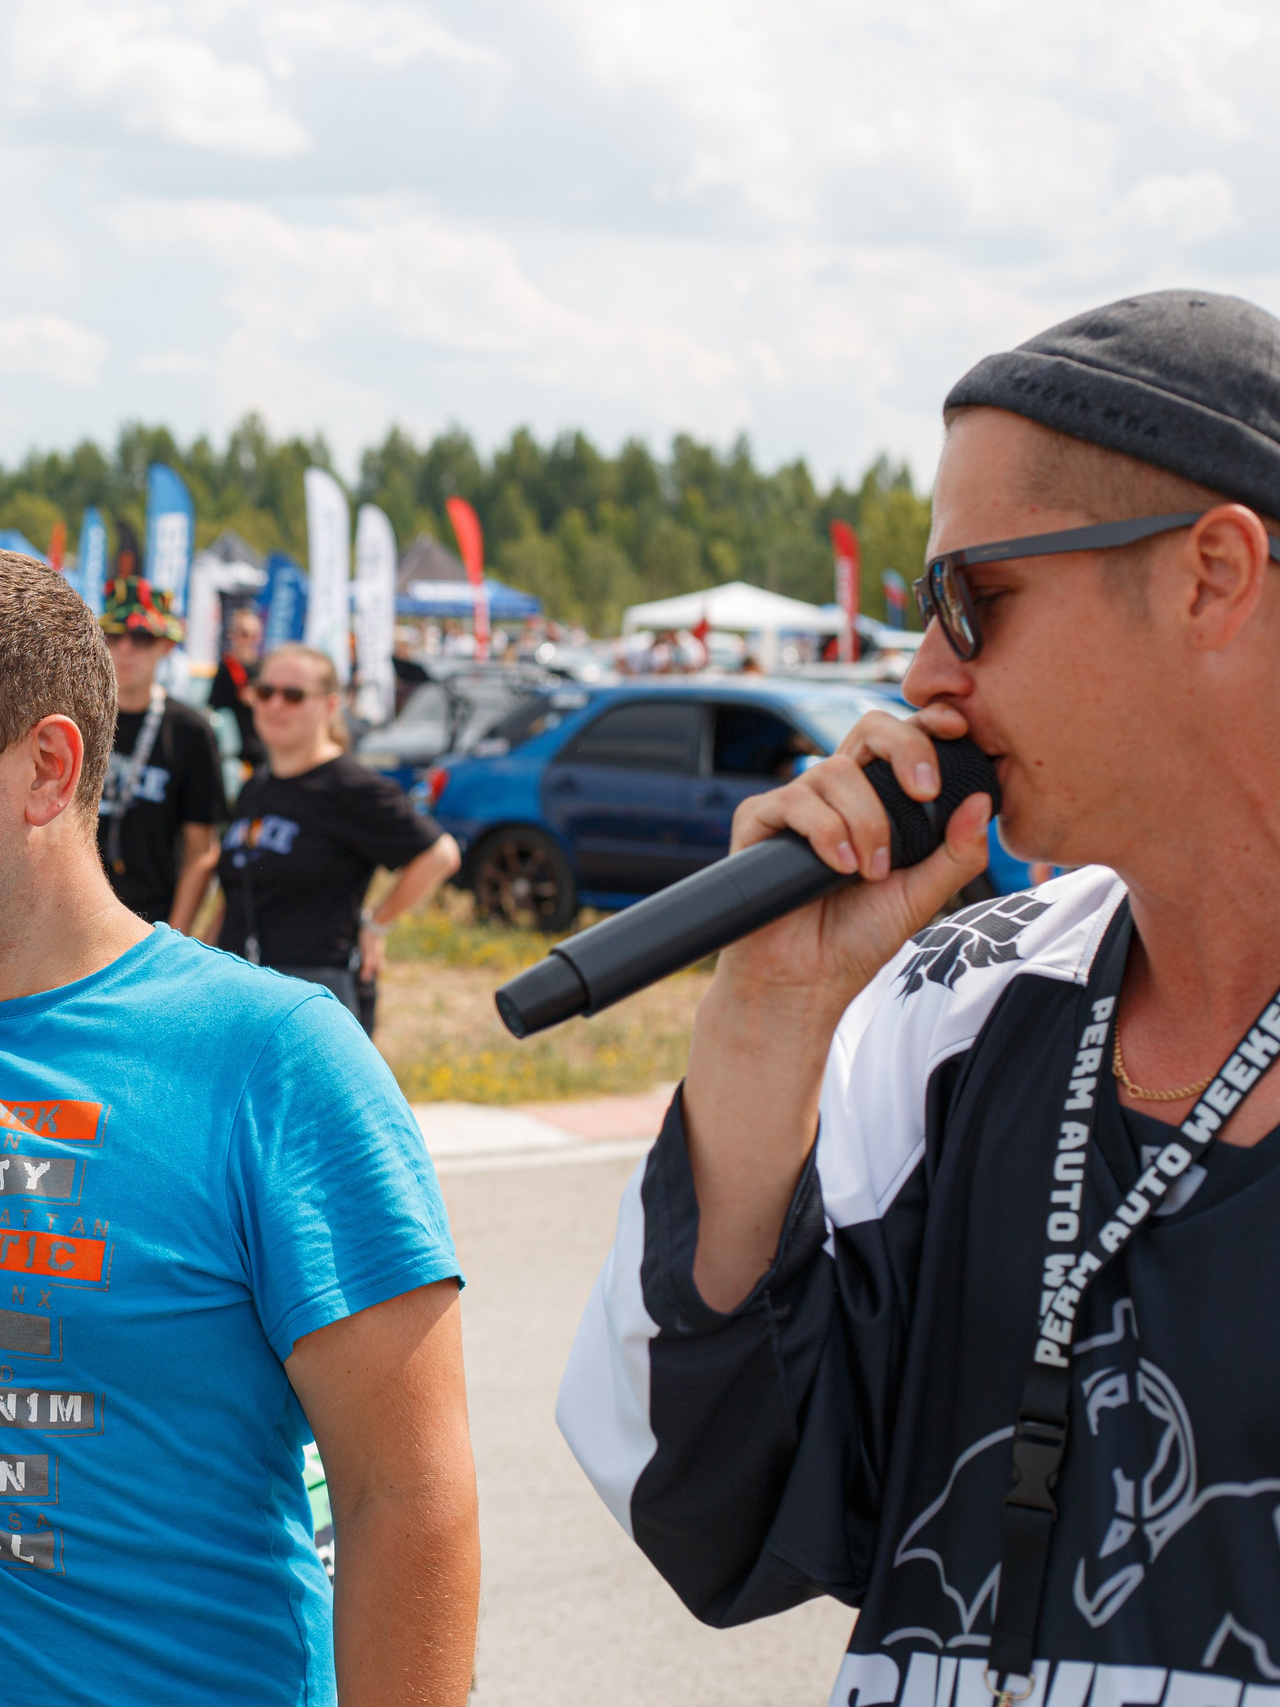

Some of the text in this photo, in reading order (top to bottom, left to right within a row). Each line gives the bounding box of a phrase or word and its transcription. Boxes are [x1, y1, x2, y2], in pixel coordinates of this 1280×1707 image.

[1064, 995, 1116, 1111] PERM
[1033, 1250, 1103, 1368] PERM
[1098, 1142, 1193, 1253] AUTO
[1180, 990, 1280, 1145] WEEKE
[1046, 1121, 1091, 1242] AUTO
